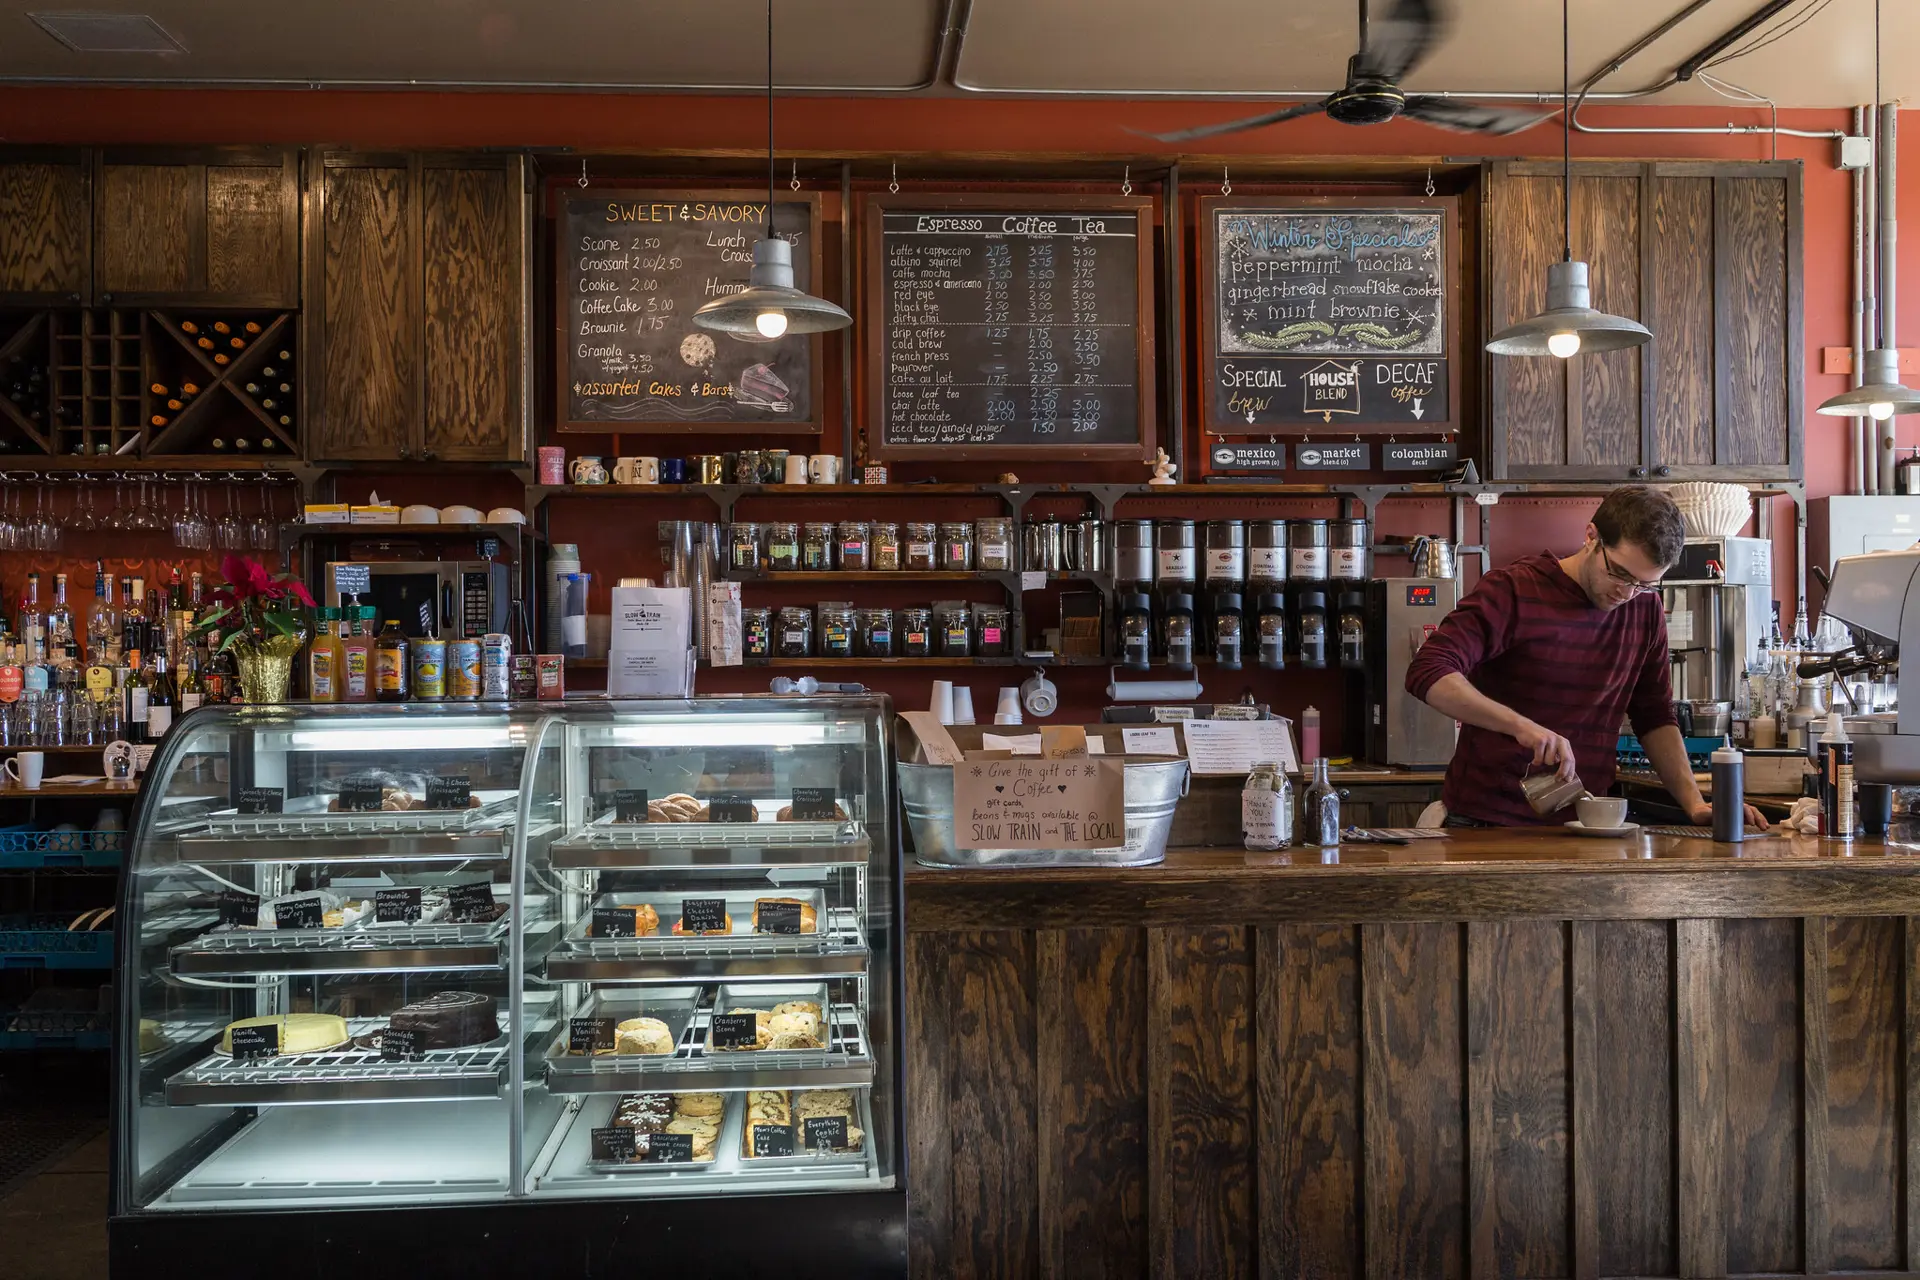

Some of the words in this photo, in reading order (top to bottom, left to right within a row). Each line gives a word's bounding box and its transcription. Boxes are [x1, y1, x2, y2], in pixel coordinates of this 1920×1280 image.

[606, 203, 677, 222] SWEET
[680, 204, 690, 221] &
[692, 204, 767, 224] SAVORY
[917, 216, 982, 233] Espresso
[1002, 216, 1057, 234] Coffee
[1071, 217, 1106, 234] Tea
[580, 236, 620, 251] Scone
[631, 238, 661, 250] 2.50
[706, 229, 746, 248] Lunch
[1228, 217, 1321, 250] Winter
[1326, 217, 1438, 261] Specials
[924, 246, 971, 257] cappuccino
[580, 253, 630, 271] Croissant
[890, 256, 920, 267] albino
[929, 257, 962, 268] squirrel
[892, 267, 915, 278] caffe
[921, 268, 950, 278] mocha
[988, 270, 1013, 280] 3.00
[1231, 256, 1341, 282] peppermint
[1356, 256, 1413, 273] mocha
[580, 277, 619, 292] Cookie
[630, 278, 658, 291] 2.00
[894, 280, 933, 290] espresso
[944, 280, 982, 289] americano
[894, 289, 911, 300] red
[916, 290, 935, 303] eye
[1072, 290, 1096, 300] 3.00
[1228, 278, 1327, 305] gingerbread
[1333, 279, 1400, 296] snowflake
[1402, 282, 1443, 297] cookie
[580, 299, 613, 314] Coffee
[613, 295, 641, 313] Cake
[647, 297, 674, 313] 3.00
[894, 301, 920, 312] black
[924, 303, 940, 313] eye
[1268, 299, 1316, 319] mint
[1329, 297, 1400, 319] brownie
[893, 312, 917, 325] dirty
[920, 312, 940, 323] chai
[985, 312, 1009, 323] 2.75
[1028, 312, 1054, 323] 3.25
[1072, 313, 1098, 323] 3.75
[580, 320, 627, 336] Brownie
[892, 326, 912, 339] drip
[915, 328, 946, 339] coffee
[986, 328, 1010, 338] 1.25
[1028, 328, 1051, 339] 1.75
[1073, 329, 1099, 341] 2.25
[578, 343, 622, 358] Granola
[892, 339, 914, 350] cold
[919, 339, 943, 349] brew
[1028, 339, 1053, 349] 2.00
[1074, 341, 1099, 352] 2.50
[628, 353, 652, 363] 3.50
[892, 351, 921, 362] french
[924, 353, 950, 362] press
[1027, 350, 1053, 360] 2.50
[1074, 353, 1100, 366] 3.50
[631, 364, 654, 373] 4.50
[892, 363, 934, 373] pourover
[1028, 362, 1058, 372] 2.50
[1376, 362, 1438, 384] DECAF
[891, 372, 915, 383] cafe
[936, 371, 953, 383] lait
[1221, 363, 1287, 388] SPECIAL
[1309, 372, 1355, 386] HOUSE
[582, 377, 641, 396] assorted
[649, 381, 682, 397] Cakes
[702, 383, 727, 396] Bars
[892, 387, 914, 399] loose
[921, 387, 940, 398] leaf
[946, 387, 960, 399] tea
[1030, 387, 1062, 400] 2.25
[1390, 384, 1433, 403] coffee
[1315, 388, 1348, 400] BLEND
[891, 401, 911, 411] chai
[917, 399, 941, 410] latte
[987, 400, 1016, 411] 2.00
[1030, 399, 1057, 411] 2.50
[1072, 400, 1101, 411] 3.00
[1227, 391, 1273, 415] brew
[891, 411, 906, 422] hot
[910, 411, 952, 422] chocolate
[987, 411, 1016, 421] 2.00
[1031, 411, 1058, 421] 2.50
[1072, 411, 1101, 421] 3.00
[891, 422, 913, 433] iced
[1033, 422, 1056, 433] 1.50
[1073, 422, 1098, 432] 2.00
[1236, 447, 1276, 458] mexico
[1323, 448, 1361, 458] market
[1391, 448, 1448, 459] colombian
[1236, 459, 1250, 468] high
[1251, 460, 1270, 468] grown
[1051, 748, 1086, 759] Espresso
[988, 762, 1011, 777] Give
[1018, 763, 1032, 777] the
[1039, 764, 1060, 782] gift
[1065, 765, 1078, 777] of
[1013, 778, 1053, 798] Coffee
[986, 799, 1000, 808] gift
[972, 808, 999, 820] beans
[1012, 812, 1035, 824] mugs
[1042, 809, 1079, 821] available
[1088, 811, 1099, 822] @
[971, 823, 1001, 842] SLOW
[1008, 823, 1041, 841] TRAIN
[1060, 822, 1079, 842] THE
[1084, 822, 1121, 842] LOCAL
[376, 892, 411, 900] Brownie
[276, 904, 293, 914] Berry
[294, 900, 320, 909] Oatmeal
[686, 900, 720, 908] Raspberry
[278, 911, 291, 919] Bar
[571, 1019, 605, 1027] Lavender
[714, 1016, 747, 1026] Cranberry
[233, 1028, 257, 1036] Vanilla
[383, 1029, 414, 1039] Chocolate
[575, 1027, 600, 1035] Vanilla
[716, 1025, 736, 1033] Scone
[382, 1037, 410, 1046] Ganache
[807, 1119, 840, 1129] Everything
[815, 1128, 839, 1138] Cookie
